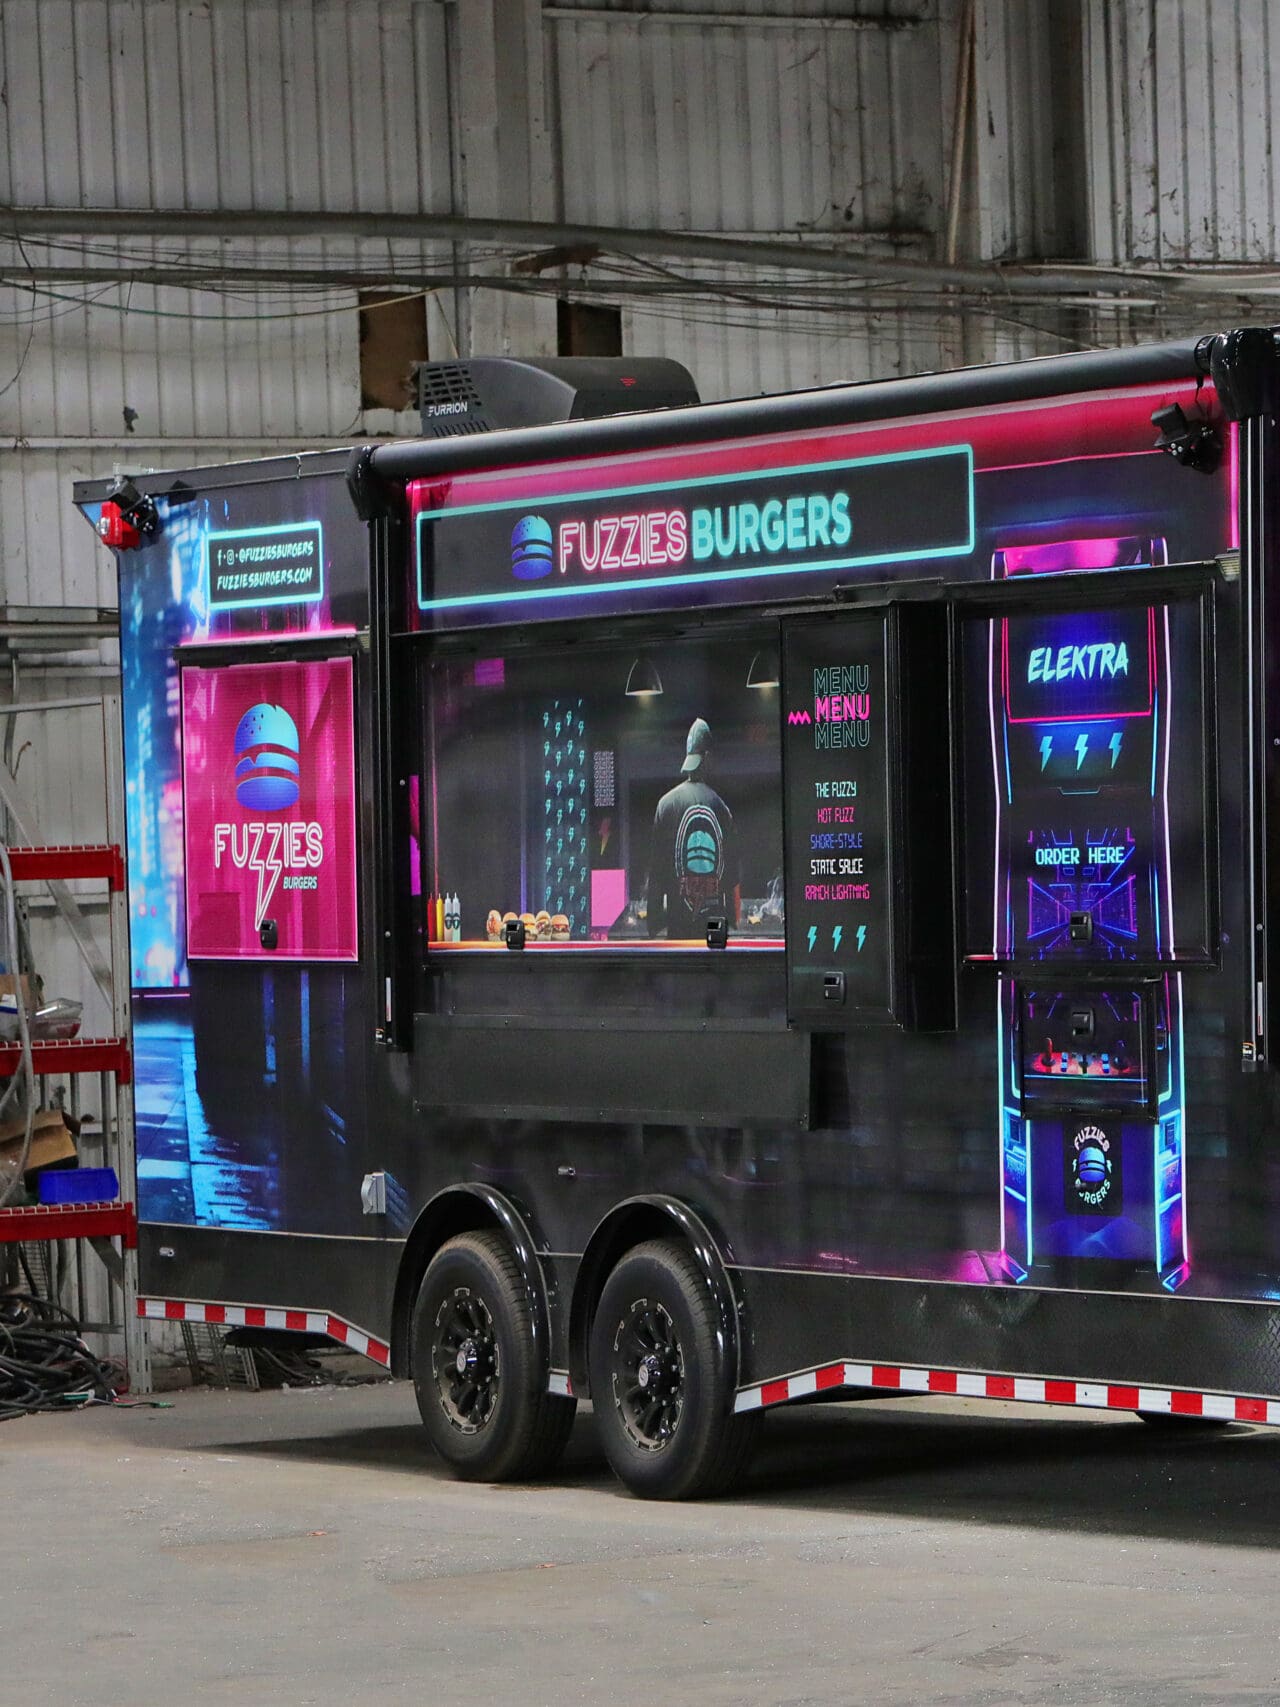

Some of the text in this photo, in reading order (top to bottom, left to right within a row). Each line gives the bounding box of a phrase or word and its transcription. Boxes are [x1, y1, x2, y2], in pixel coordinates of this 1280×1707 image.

[428, 400, 468, 417] FURRION
[559, 491, 851, 574] FUZZIES BURGERS
[216, 566, 313, 591] FUZZIESBURGERS.COM
[1028, 641, 1129, 683] ELEKTRA
[813, 664, 869, 695] MENU
[815, 693, 870, 722] MENU
[814, 719, 870, 750] MENU
[815, 781, 857, 798] THE FUZZY
[817, 806, 855, 823] HOT FUZZ
[810, 832, 863, 850] SHORE-STYLE
[1035, 846, 1125, 865] ORDER HERE
[810, 858, 863, 875] STATIC SAUCE
[283, 876, 318, 890] BURGERS
[804, 883, 870, 901] RANCH LIGHTNING
[1074, 1126, 1111, 1152] FUZZIES
